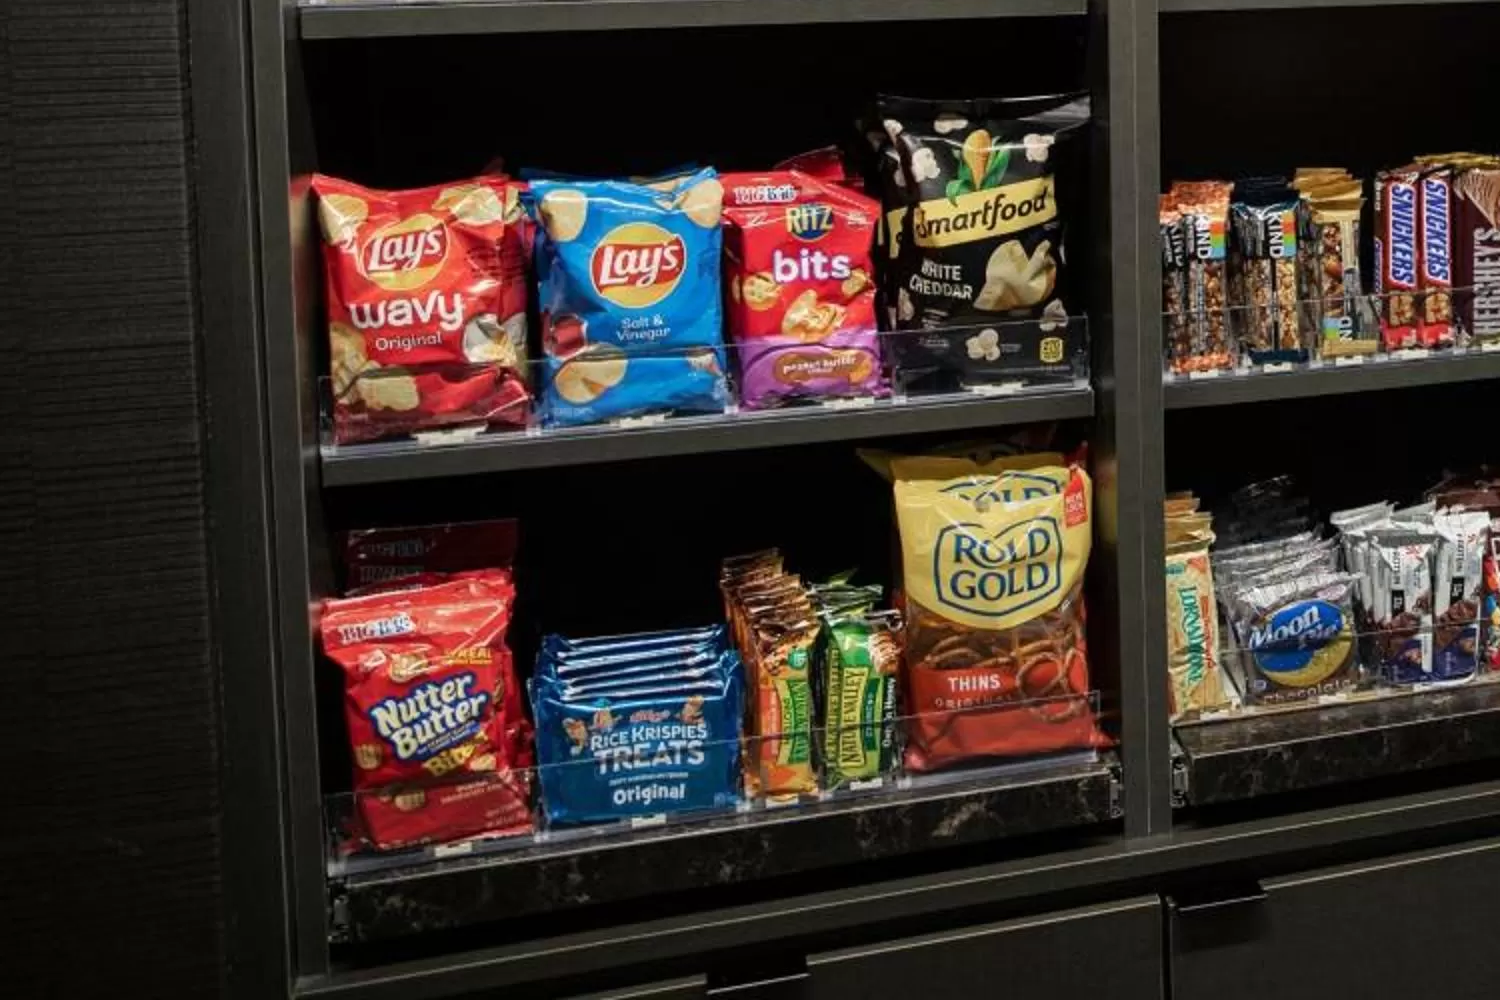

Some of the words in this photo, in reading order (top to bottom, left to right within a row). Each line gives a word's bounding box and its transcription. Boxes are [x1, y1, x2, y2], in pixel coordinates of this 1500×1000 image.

[367, 225, 444, 273] Lay's
[1267, 212, 1283, 258] KIND
[1391, 183, 1416, 285] SNICKERS
[1425, 179, 1449, 282] SNICKERS
[600, 241, 683, 289] Lay's
[773, 248, 852, 284] bits
[921, 257, 962, 281] WHITE
[909, 274, 974, 301] CHEDDAR
[347, 289, 467, 332] wavy
[620, 318, 650, 331] Salt
[651, 315, 664, 327] &
[375, 332, 443, 352] Original
[616, 326, 672, 342] Vinegar
[953, 527, 1051, 568] ROLD
[949, 563, 1050, 601] GOLD
[1250, 605, 1321, 647] Moon
[947, 673, 1002, 693] THINS
[371, 674, 474, 738] Nutter
[391, 694, 487, 760] Butter
[591, 732, 630, 751] RICE
[631, 722, 708, 743] KRISPIES
[593, 739, 705, 775] TREATS
